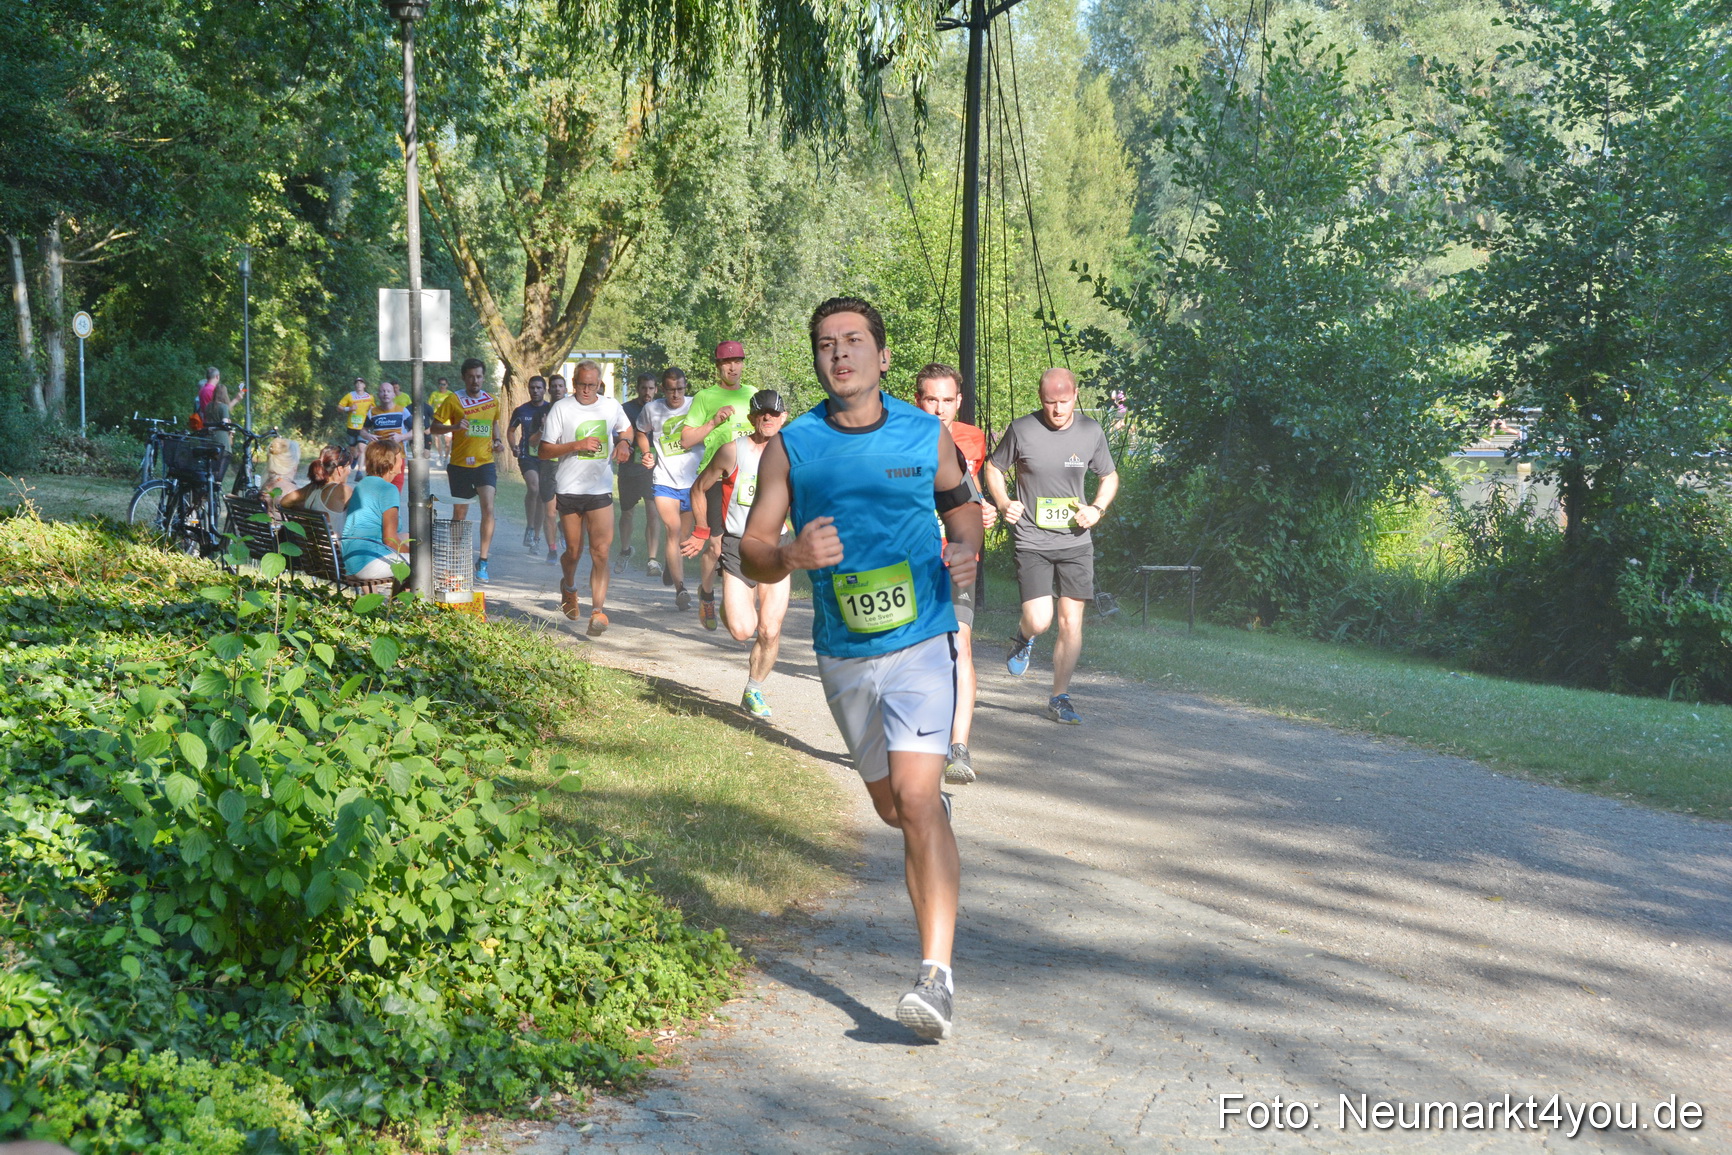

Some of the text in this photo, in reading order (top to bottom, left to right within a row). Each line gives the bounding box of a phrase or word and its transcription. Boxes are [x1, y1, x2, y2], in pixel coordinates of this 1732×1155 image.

[464, 408, 481, 416] MAX
[471, 425, 490, 433] 1330
[667, 440, 682, 450] 149
[885, 466, 922, 479] THULE
[1045, 508, 1069, 520] 319
[846, 586, 906, 617] 1936
[877, 612, 894, 620] Sven
